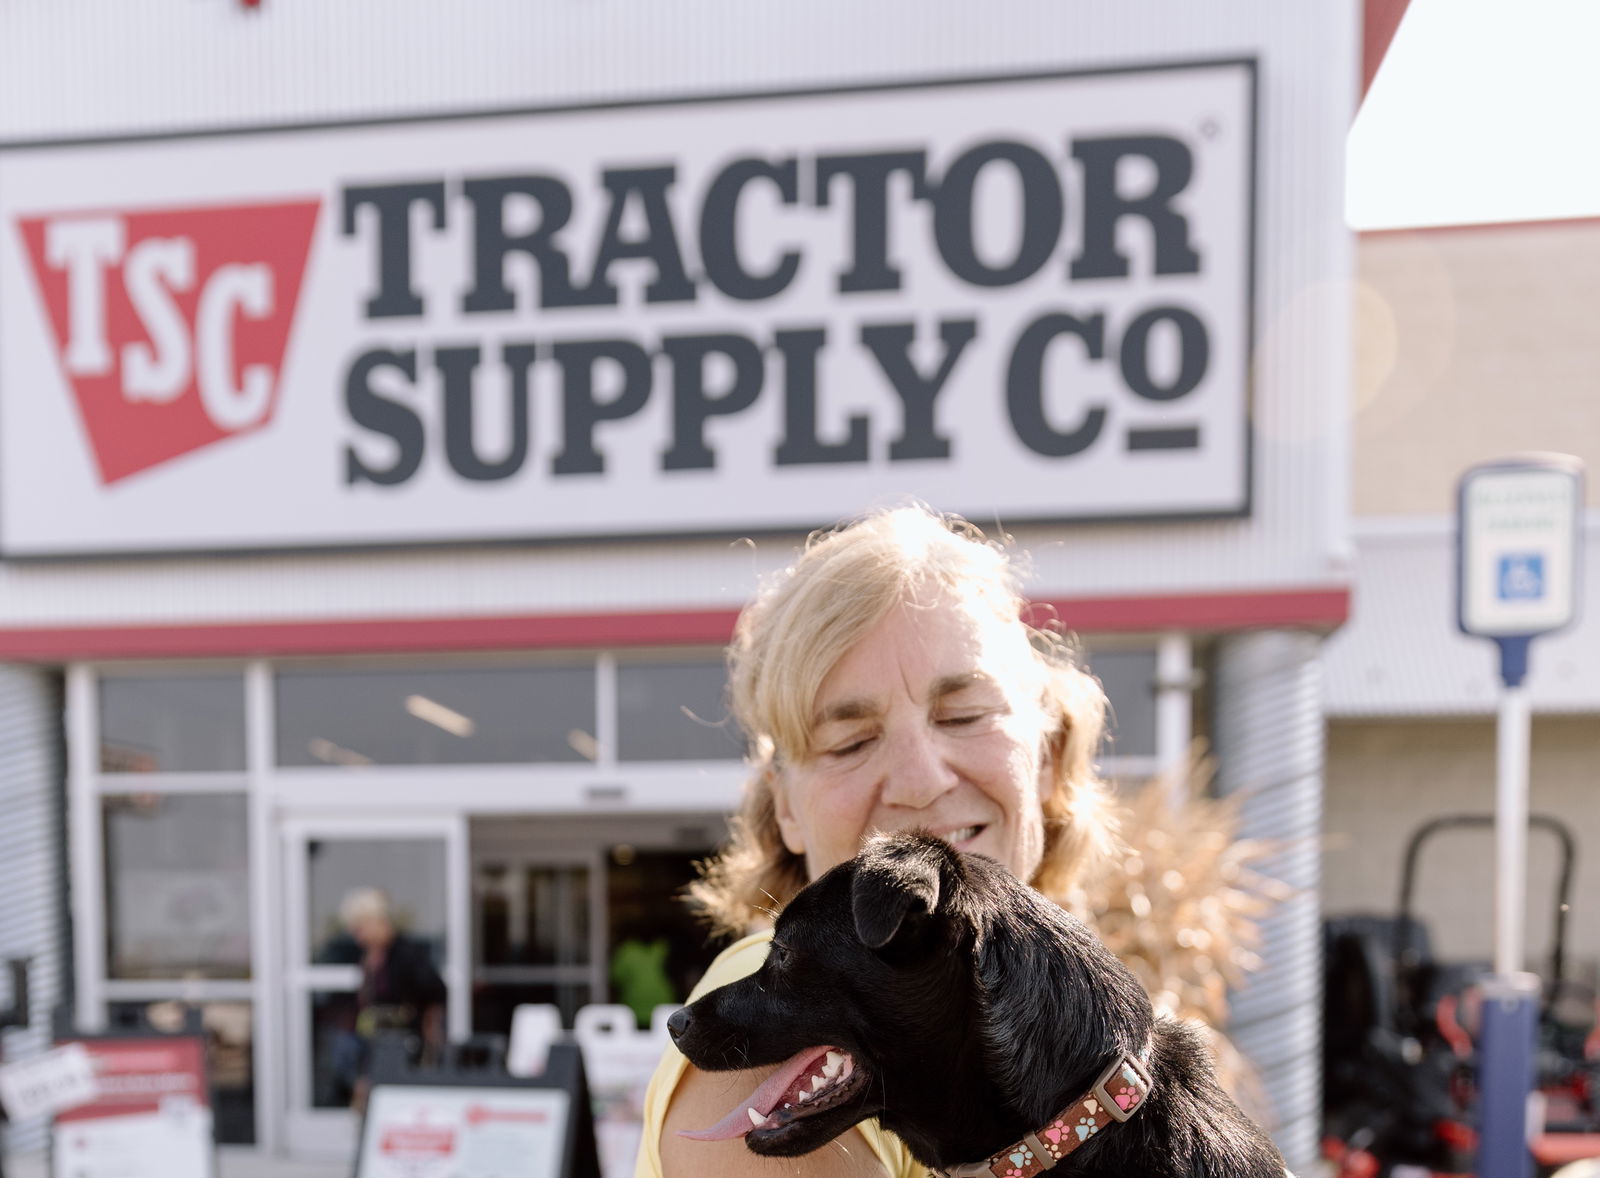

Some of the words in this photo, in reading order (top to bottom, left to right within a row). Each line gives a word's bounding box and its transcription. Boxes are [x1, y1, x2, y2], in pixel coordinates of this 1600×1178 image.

[340, 134, 1202, 321] TRACTOR
[44, 212, 276, 433] TSC
[341, 317, 980, 487] SUPPLY
